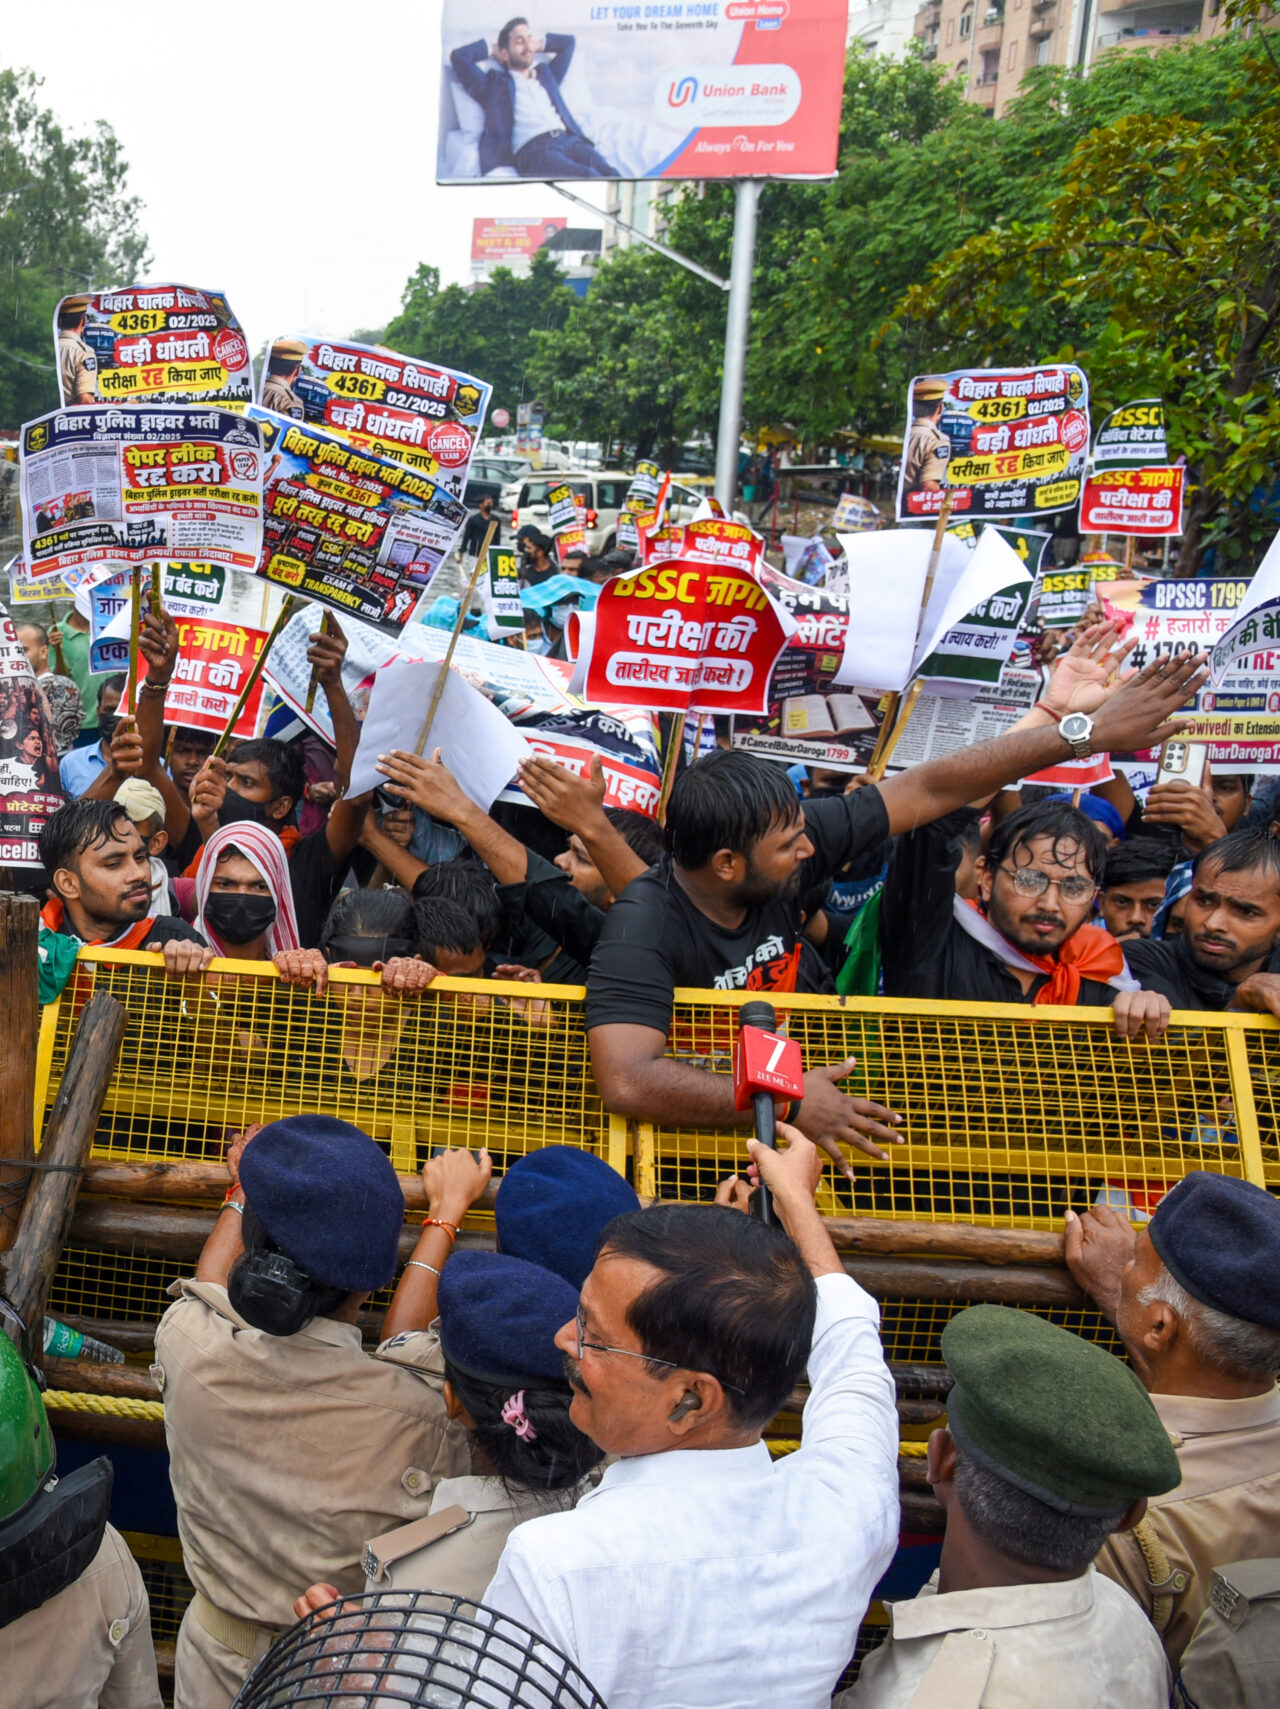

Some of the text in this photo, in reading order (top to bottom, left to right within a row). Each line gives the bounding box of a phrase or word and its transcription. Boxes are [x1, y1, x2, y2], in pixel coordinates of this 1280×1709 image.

[591, 3, 718, 20] LET YOUR DREAM HOME
[729, 5, 783, 16] Union Home
[636, 23, 647, 31] You
[661, 22, 673, 30] The
[675, 21, 703, 30] Seventh
[703, 83, 787, 97] Union Bank
[695, 142, 731, 155] Always
[757, 142, 774, 151] For
[777, 142, 794, 151] You
[100, 288, 210, 311] बिहार चालक सिपाही
[118, 313, 218, 330] 4361 02/2025
[119, 337, 152, 367] बड़ी
[156, 332, 210, 360] धांधली
[216, 341, 243, 357] CANCEL
[226, 355, 242, 365] EXAM
[102, 373, 137, 390] परीक्षा
[168, 370, 196, 383] किया
[200, 366, 222, 381] जाए
[317, 345, 451, 397] बिहार चालक सिपाही
[958, 372, 1065, 399] बिहार चालक सिपाही
[334, 376, 446, 418] 4361 02/2025
[977, 398, 1065, 418] 4361 02/2025
[1110, 407, 1159, 427] BSSC
[54, 413, 220, 434] बिहार पुलिस ड्राइवर भर्ती
[331, 404, 365, 434] बड़ी
[366, 412, 427, 445] धांधली
[93, 431, 181, 441] विज्ञापन संख्या 02/2025
[430, 438, 467, 450] CANCEL
[976, 416, 1058, 454] बड़ी धांधली
[126, 449, 166, 467] पेपर
[171, 445, 216, 463] लीक
[282, 427, 319, 457] बिहार
[314, 442, 350, 468] पुलिस
[348, 456, 380, 479] ड्राइवर
[379, 465, 407, 488] भर्ती
[402, 477, 436, 500] 2025
[440, 452, 460, 460] EXAM
[952, 459, 991, 478] परीक्षा
[1022, 453, 1044, 470] किया
[1047, 450, 1065, 464] जाए
[134, 462, 222, 487] रद्द करो
[316, 466, 384, 494] Advt. 2/2025
[1091, 468, 1180, 487] BSSC जागो !
[125, 487, 241, 504] बिहार पुलिस ड्राइवर भर्ती परीक्षा रद्द
[277, 482, 299, 496] बिहार
[317, 475, 372, 504] कुल पद 4361
[1099, 488, 1151, 508] परीक्षा
[1152, 489, 1172, 508] की
[274, 496, 297, 516] पूरी
[297, 504, 325, 525] तरह
[327, 516, 344, 531] रद्द
[343, 520, 374, 542] करो
[689, 523, 721, 534] BSSC
[35, 535, 58, 549] 4361
[322, 542, 342, 555] CSBC
[695, 536, 750, 558] परीक्षा की
[59, 555, 80, 566] बिहार
[82, 553, 105, 565] पुलिस
[106, 551, 128, 563] ड्राइवर
[130, 549, 144, 561] भर्ती
[271, 567, 301, 582] बंद करो
[409, 564, 426, 572] VIRAL
[175, 573, 219, 599] बंद करो
[322, 574, 355, 592] EXAM में
[613, 568, 700, 604] BSSC
[1042, 575, 1085, 592] BSSC
[303, 578, 362, 608] TRANSPARENCY
[360, 602, 382, 618] लाओ
[1155, 583, 1246, 608] BPSSC 1799
[167, 603, 187, 613] न्याय
[990, 592, 1023, 622] करो
[626, 608, 758, 653] परीक्षा की
[1145, 611, 1212, 640] # हजारों
[1239, 619, 1259, 646] की
[192, 625, 249, 656] जागो
[1130, 644, 1147, 669] #
[208, 659, 243, 691] की
[615, 658, 670, 683] तारीख
[703, 663, 736, 686] करो
[738, 669, 744, 686] !
[173, 690, 227, 713] जारी करो
[1234, 723, 1244, 734] का
[0, 775, 32, 787] चाहिए!
[6, 800, 44, 812] प्रोटेस्ट
[33, 794, 45, 802] हम
[755, 935, 785, 962] को
[757, 1072, 771, 1082] ZEE
